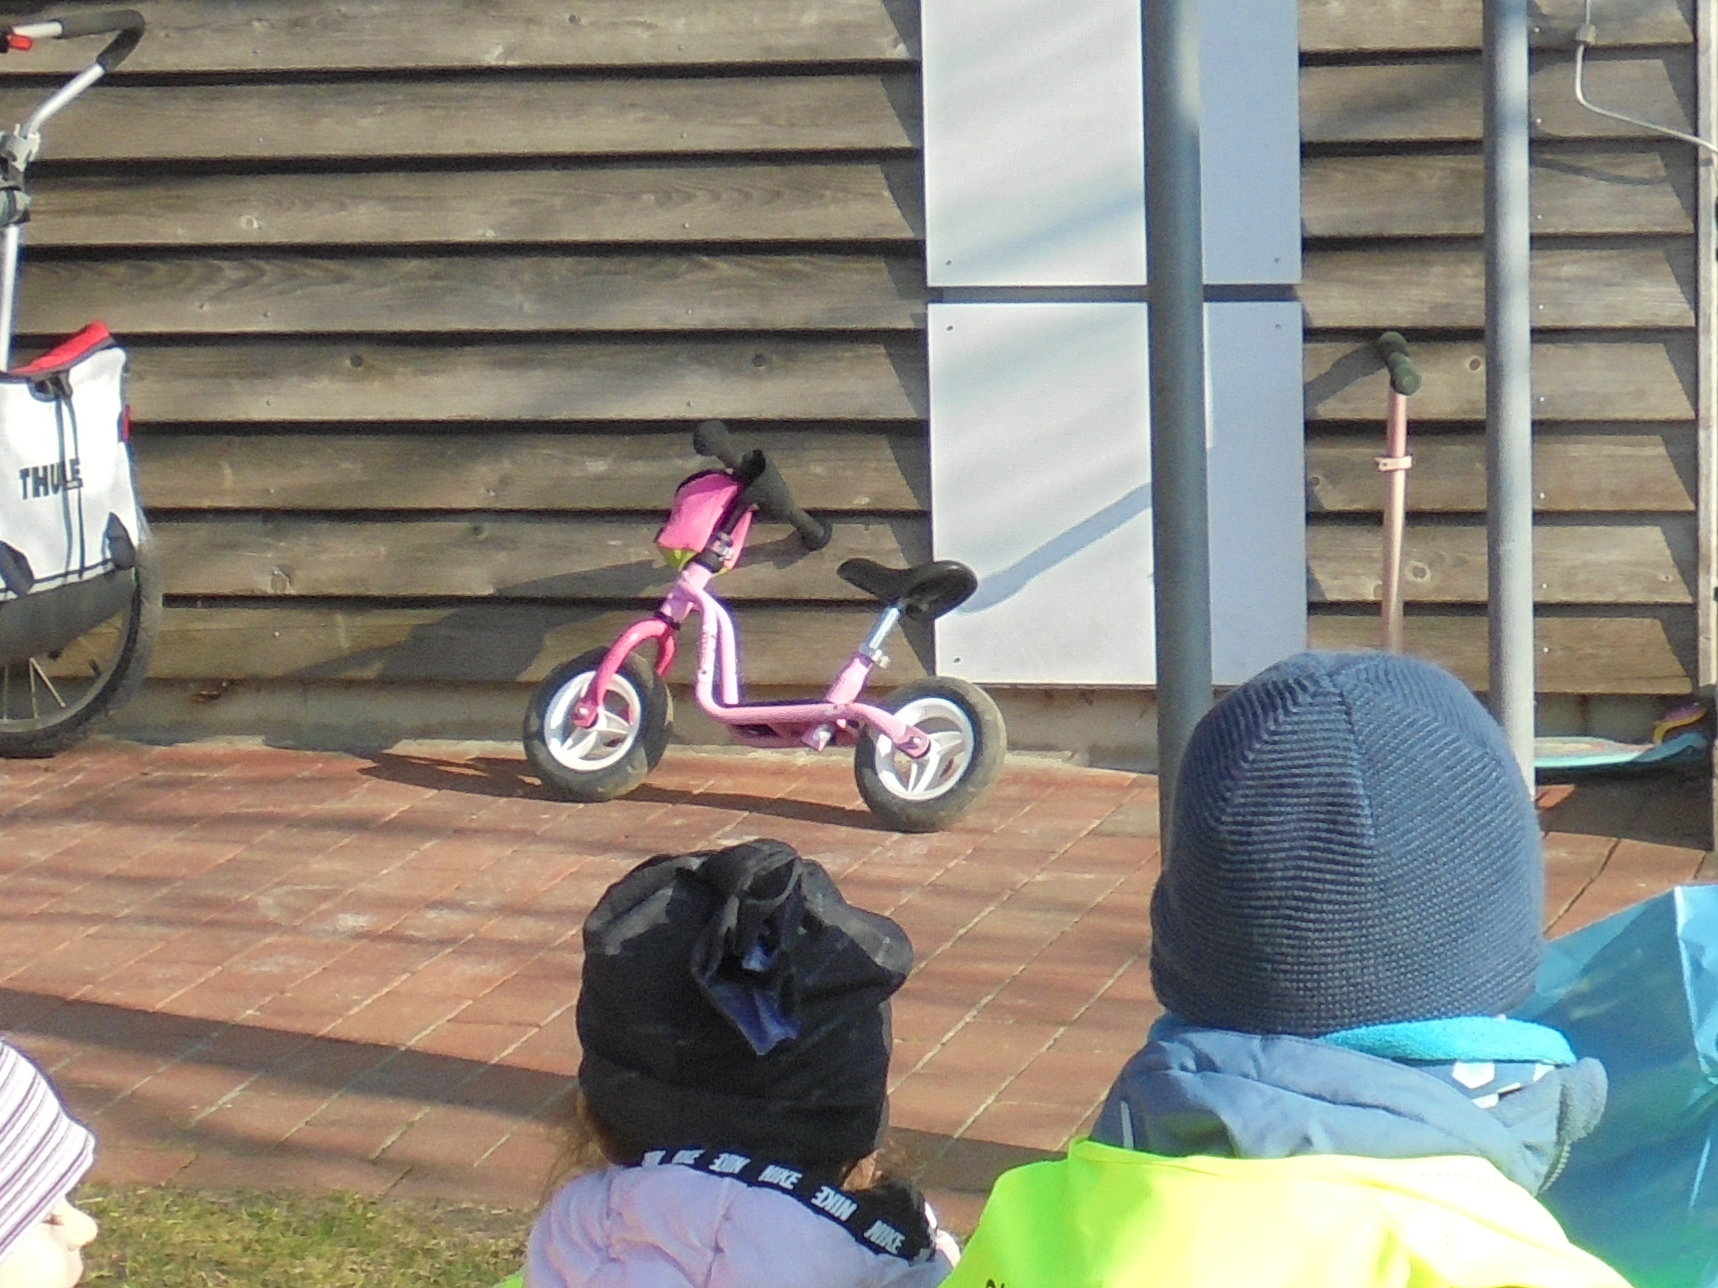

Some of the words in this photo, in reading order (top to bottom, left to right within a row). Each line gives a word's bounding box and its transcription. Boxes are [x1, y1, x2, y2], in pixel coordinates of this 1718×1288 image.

[19, 457, 84, 500] THULE
[757, 1164, 803, 1190] NIKE
[811, 1185, 858, 1222] NIKE
[863, 1219, 906, 1254] NIKE
